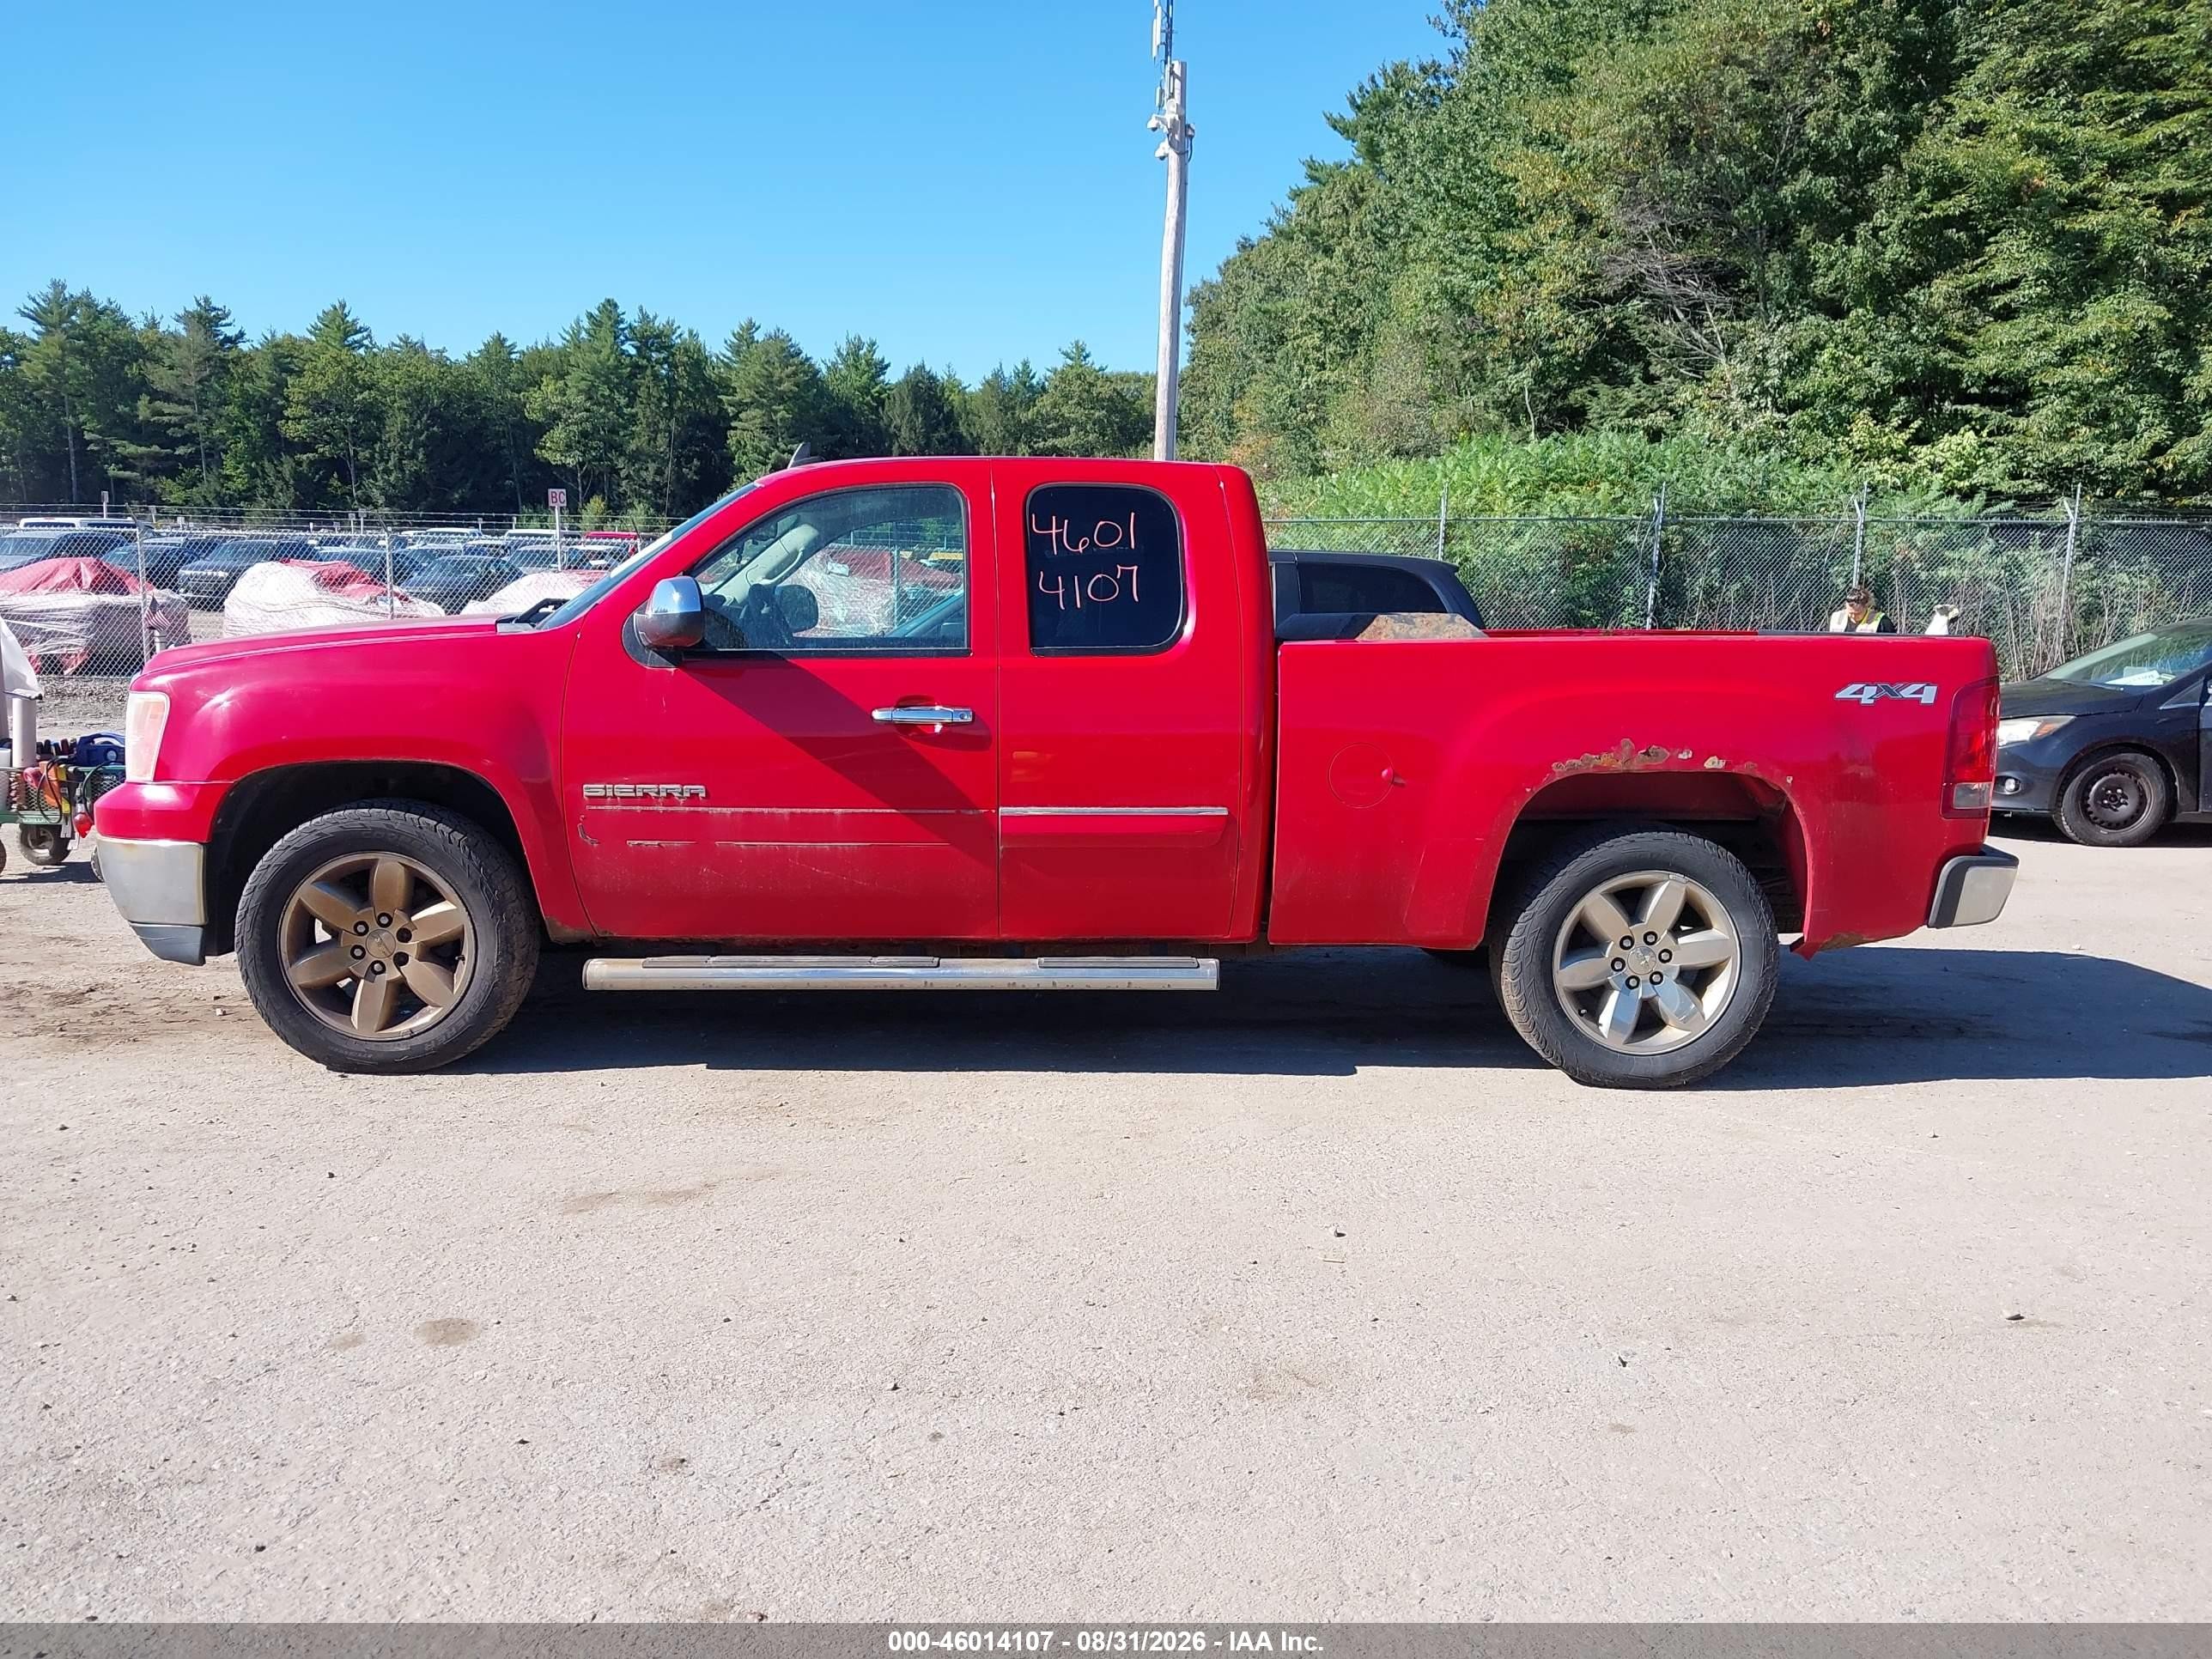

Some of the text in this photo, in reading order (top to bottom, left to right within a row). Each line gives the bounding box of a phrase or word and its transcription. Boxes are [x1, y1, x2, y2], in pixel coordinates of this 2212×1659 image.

[550, 490, 566, 504] BC
[1031, 512, 1136, 556] 4601
[1038, 564, 1139, 610] 4107
[582, 784, 706, 798] SIERRA
